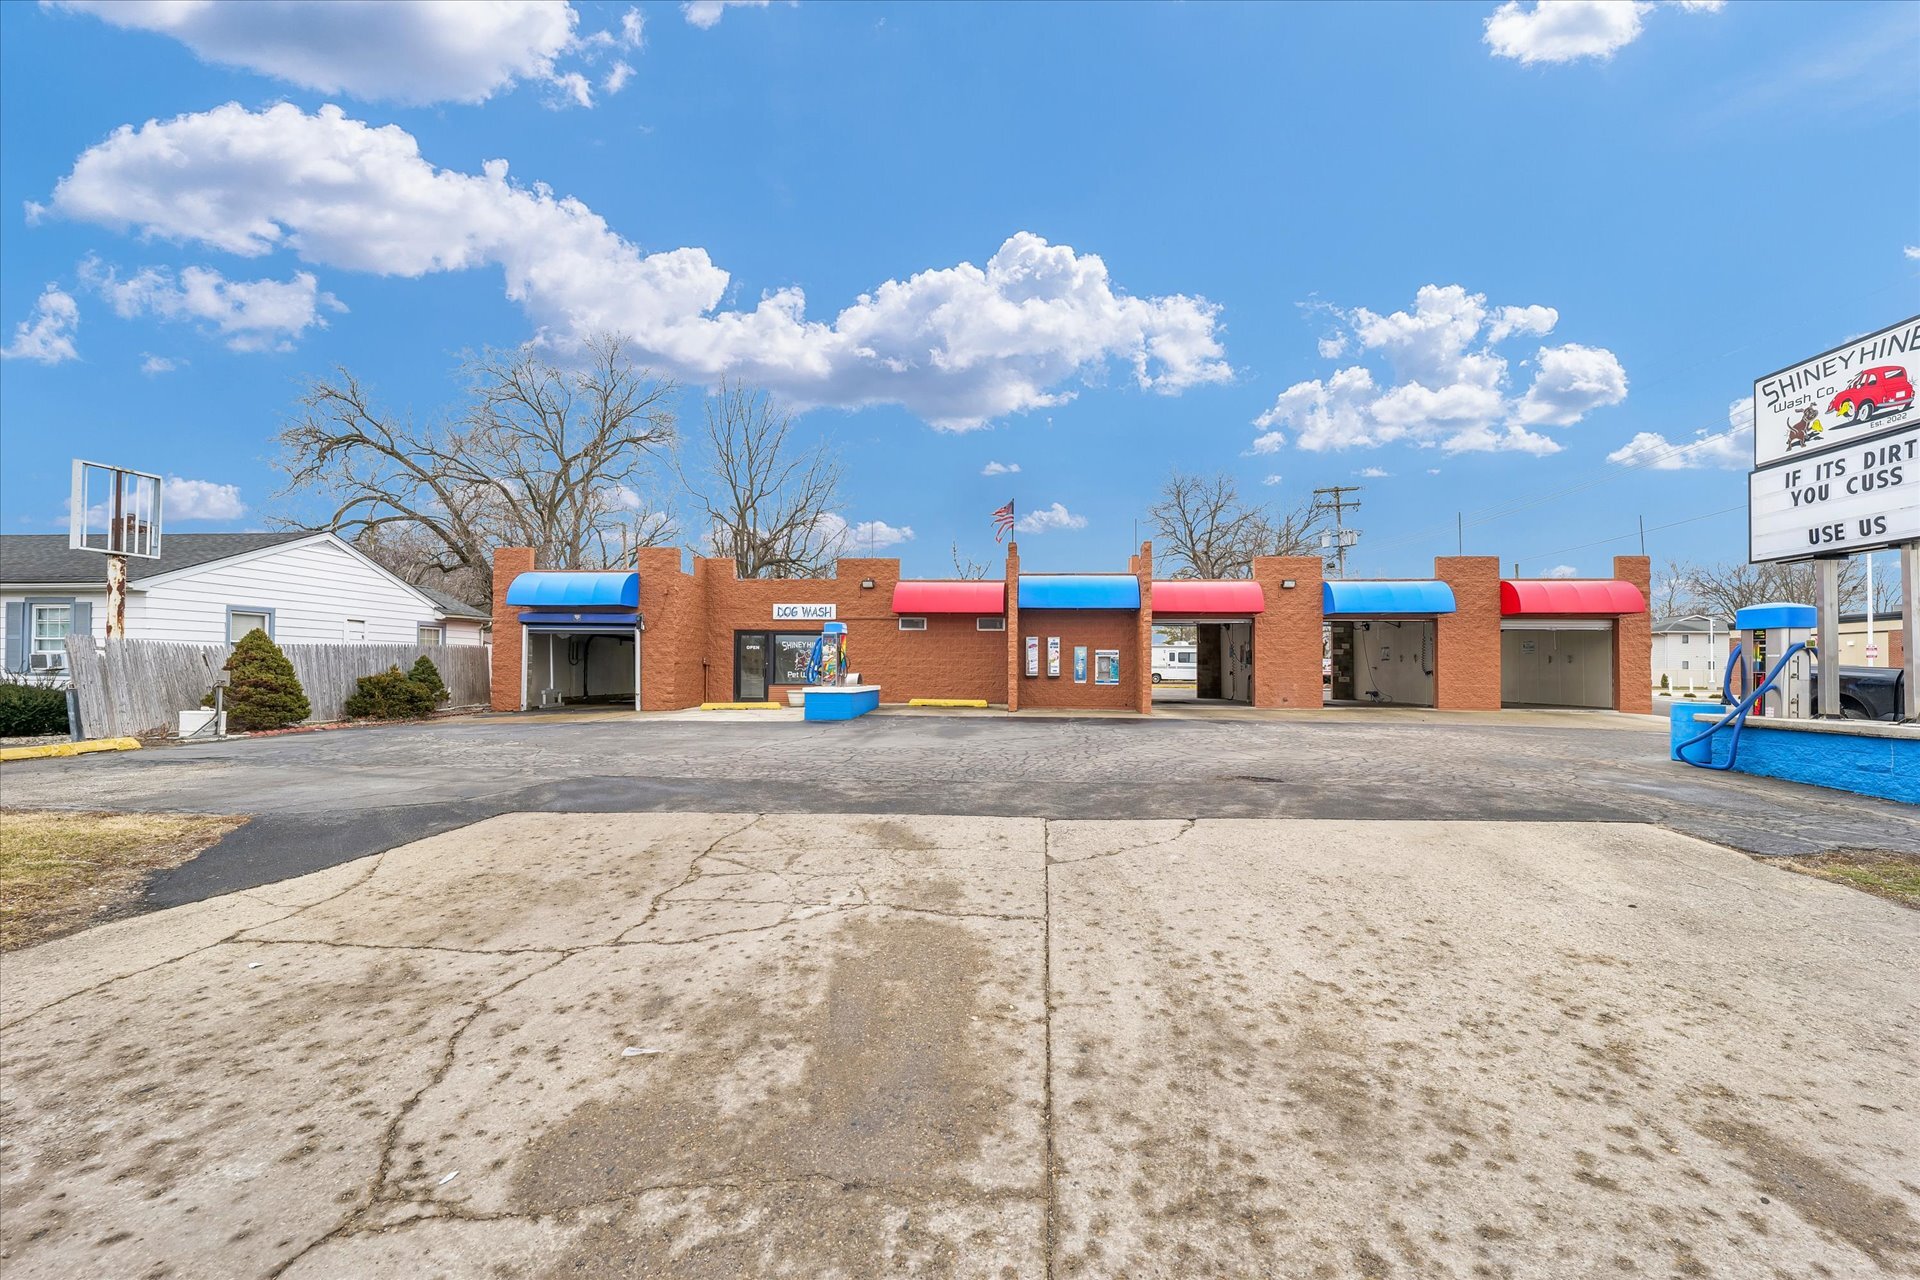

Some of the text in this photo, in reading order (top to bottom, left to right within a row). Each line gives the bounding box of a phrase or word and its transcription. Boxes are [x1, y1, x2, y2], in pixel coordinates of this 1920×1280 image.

[1773, 385, 1838, 414] Wash Co.
[1870, 412, 1908, 429] Est. 2022
[1785, 439, 1918, 489] IF ITS DIRT
[1791, 466, 1903, 507] YOU CUSS
[1808, 515, 1887, 545] USE US
[777, 606, 832, 618] DOG WASH
